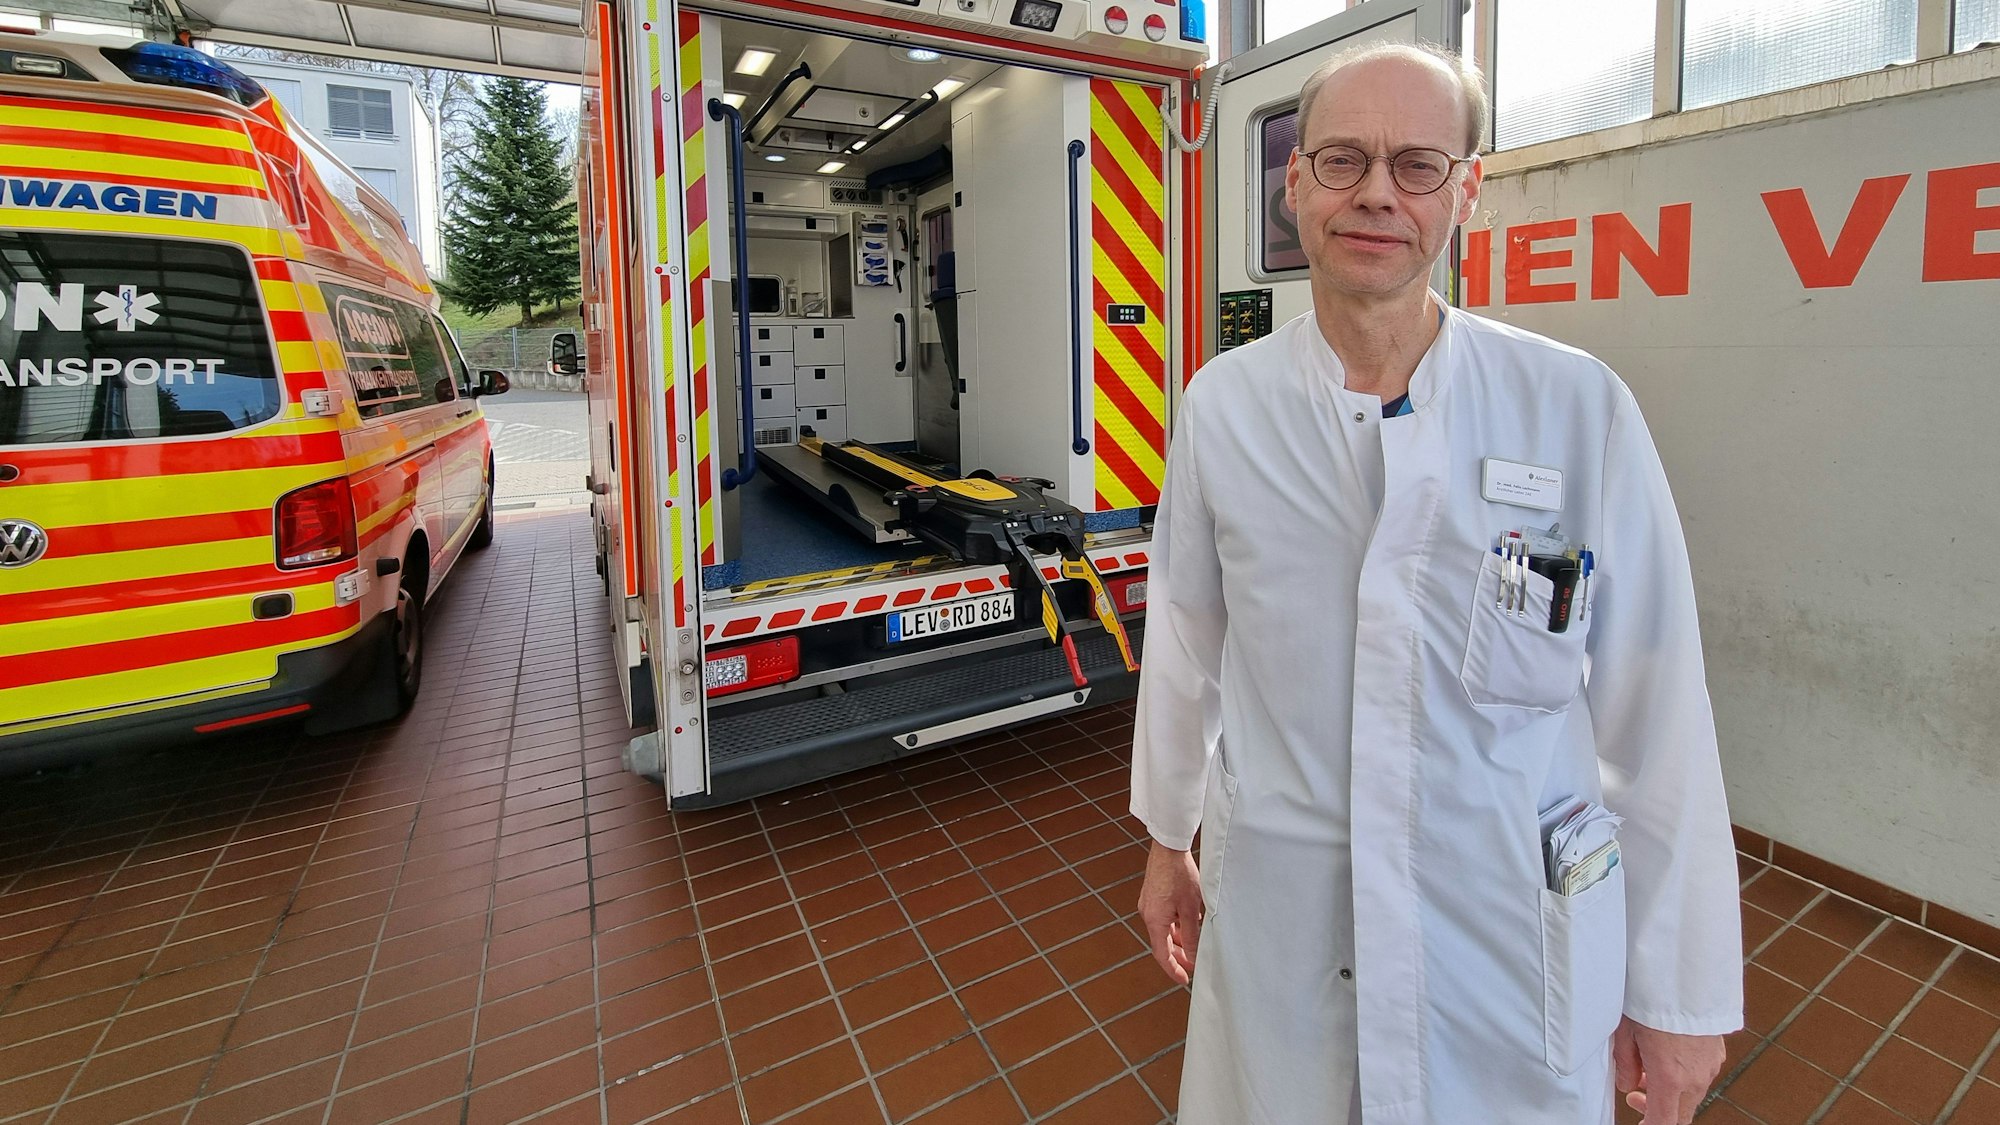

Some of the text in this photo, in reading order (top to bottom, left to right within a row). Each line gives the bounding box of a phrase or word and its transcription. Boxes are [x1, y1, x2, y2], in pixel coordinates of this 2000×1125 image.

[0, 178, 218, 220] WAGEN
[1760, 162, 2000, 289] VE
[342, 307, 395, 347] ACCON
[353, 370, 418, 391] KRANKENTRANSPORT
[891, 630, 898, 639] D
[902, 598, 1012, 637] LEV RD 884
